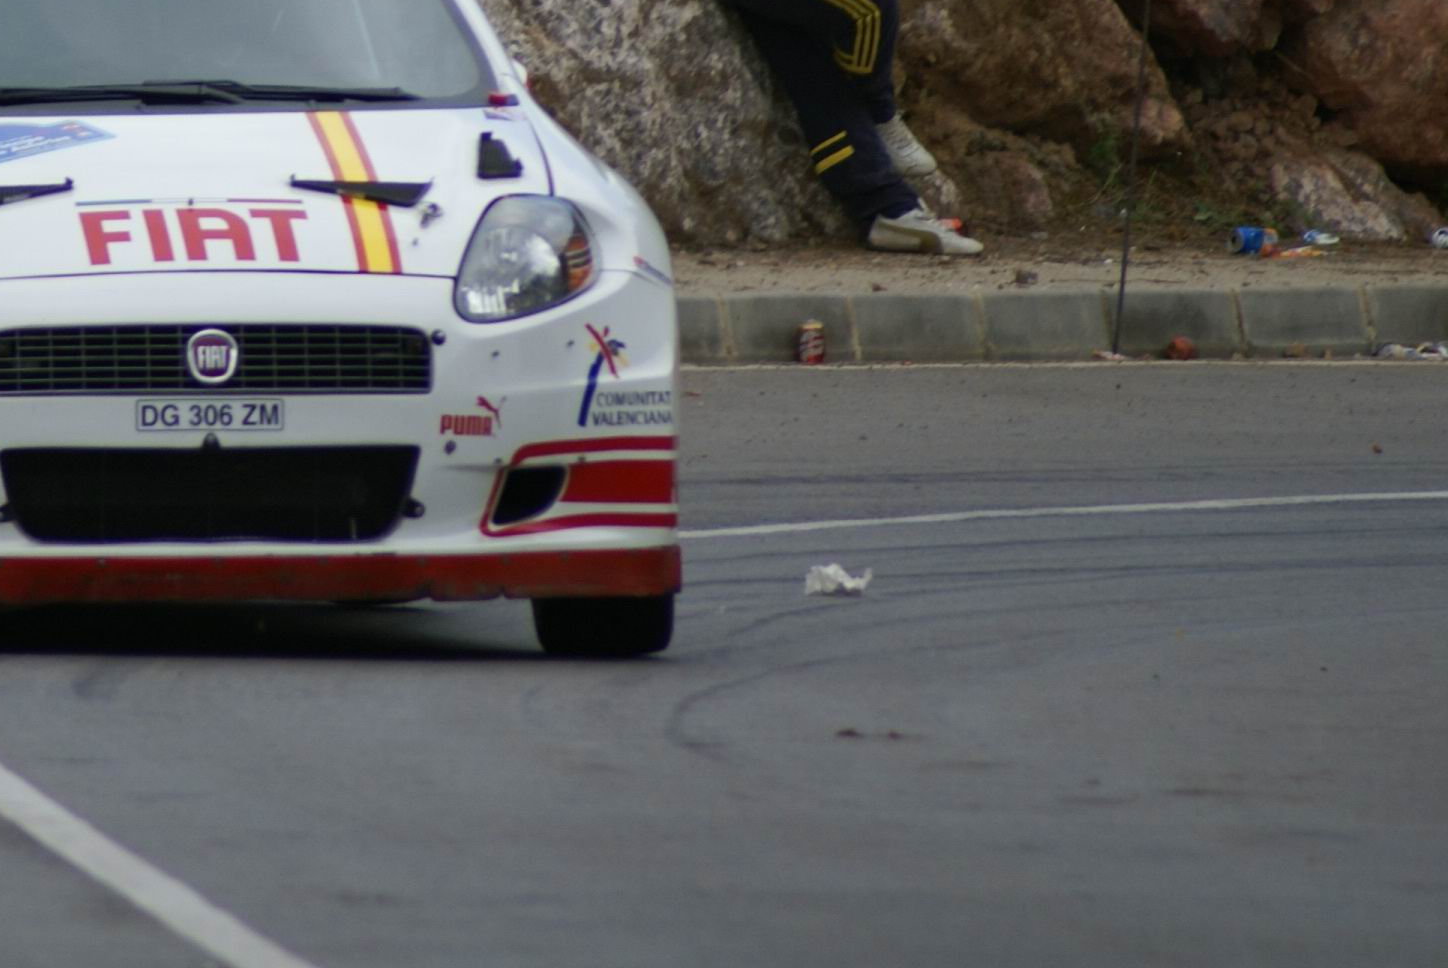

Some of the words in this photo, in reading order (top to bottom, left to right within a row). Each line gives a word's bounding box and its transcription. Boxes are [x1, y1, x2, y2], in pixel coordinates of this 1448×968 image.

[78, 207, 308, 265] FIAT
[197, 345, 228, 369] FIAT
[596, 391, 671, 407] COMUNITAT
[141, 404, 180, 427] DG
[189, 404, 233, 426] 306
[241, 403, 279, 426] ZM
[440, 414, 492, 436] PUMA
